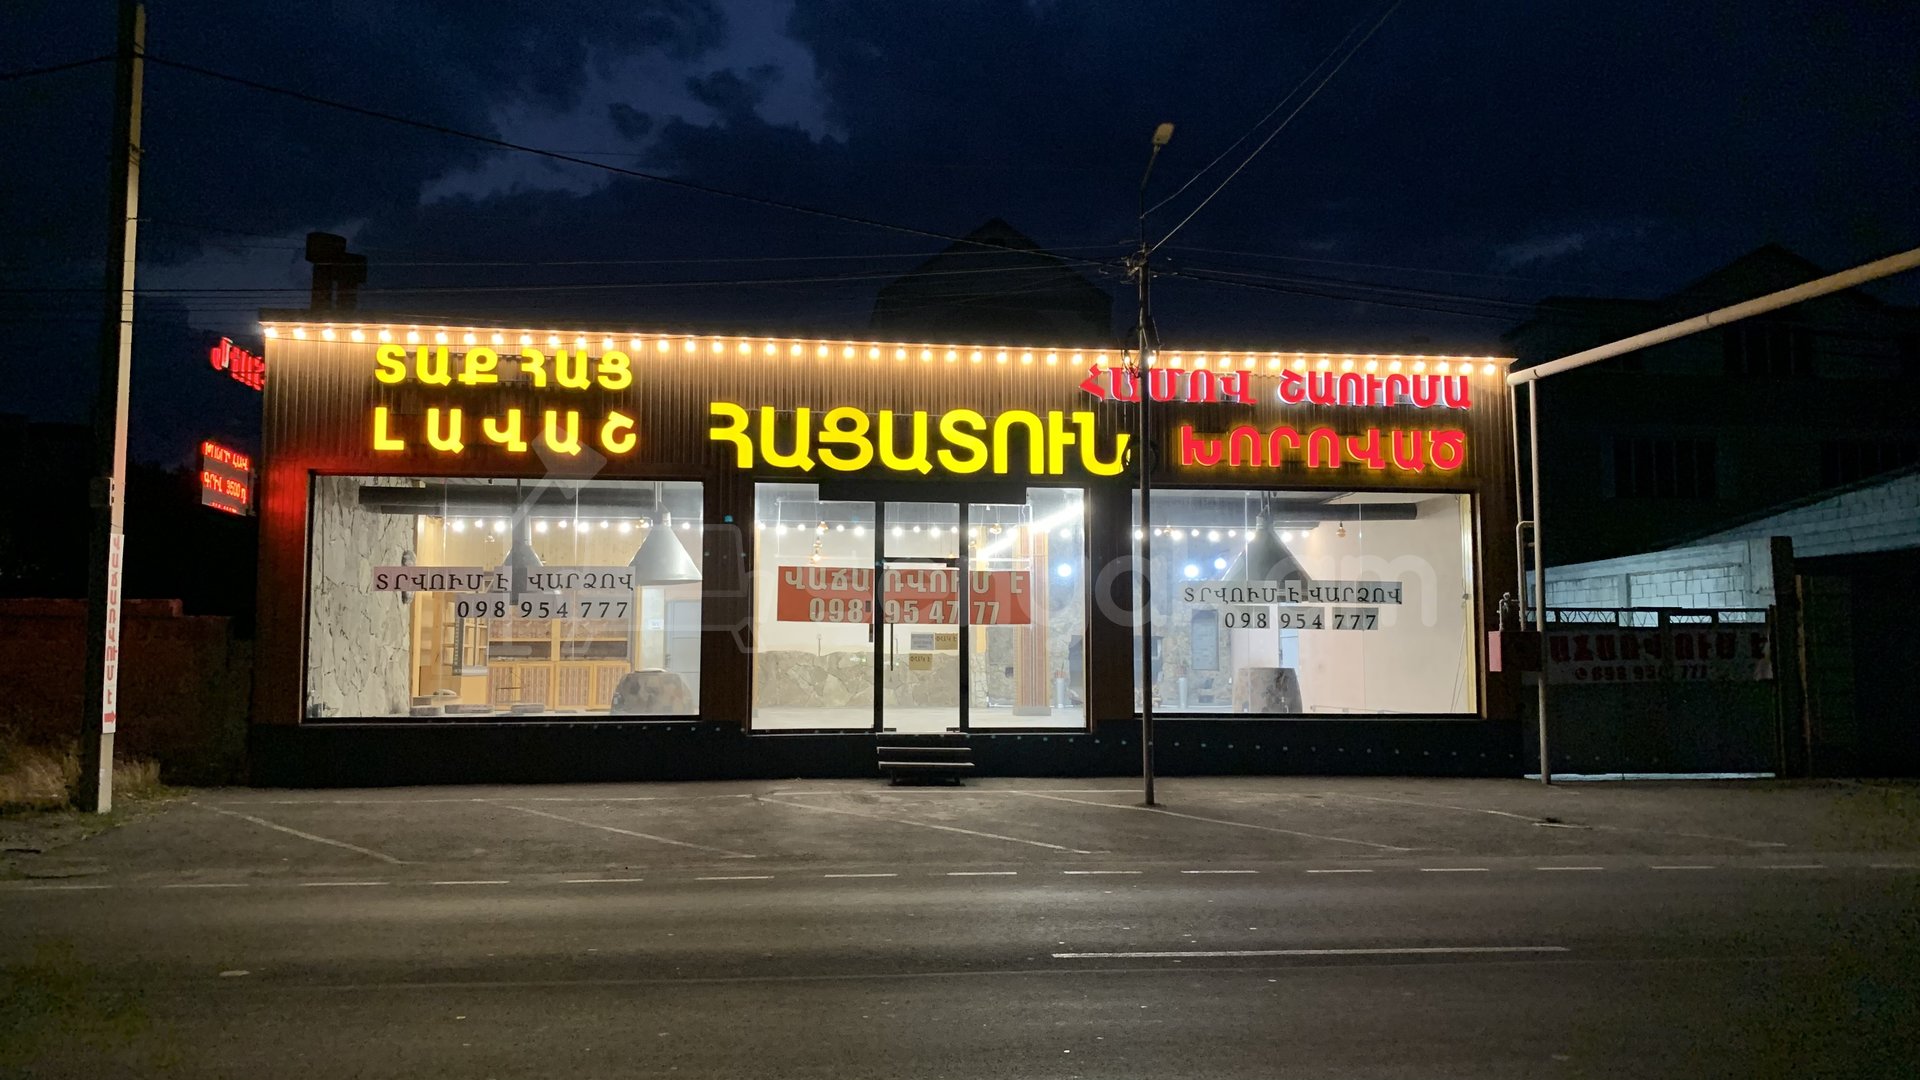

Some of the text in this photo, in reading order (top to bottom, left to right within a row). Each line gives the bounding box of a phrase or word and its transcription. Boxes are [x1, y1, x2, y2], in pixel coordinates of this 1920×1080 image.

[374, 344, 633, 390] ՏԱՔ ՀԱՑ
[1078, 363, 1472, 411] ՀԱՄՈՎ ՇԱՈՒՐՄԱ
[372, 406, 638, 455] ԼԱՎԱՇ
[709, 401, 1131, 476] ՀԱՑԱՏՈՒՆ
[1180, 424, 1467, 473] ԽՈՐՈՎԱԾ
[376, 572, 634, 592] ՏՐՎՈՒՄ Է ՎԱՐՁՈՎ
[784, 566, 1024, 594] ՎԱՃԱՌՎՈՒՄ Է
[457, 600, 629, 619] 098 954 777
[1184, 586, 1403, 605] ՏՐՎՈՒՄ Է ՎԱՐՁՈՎ
[808, 598, 864, 623] 098
[884, 599, 919, 624] 95
[973, 601, 1000, 625] 77
[1224, 612, 1378, 630] 098 954 777
